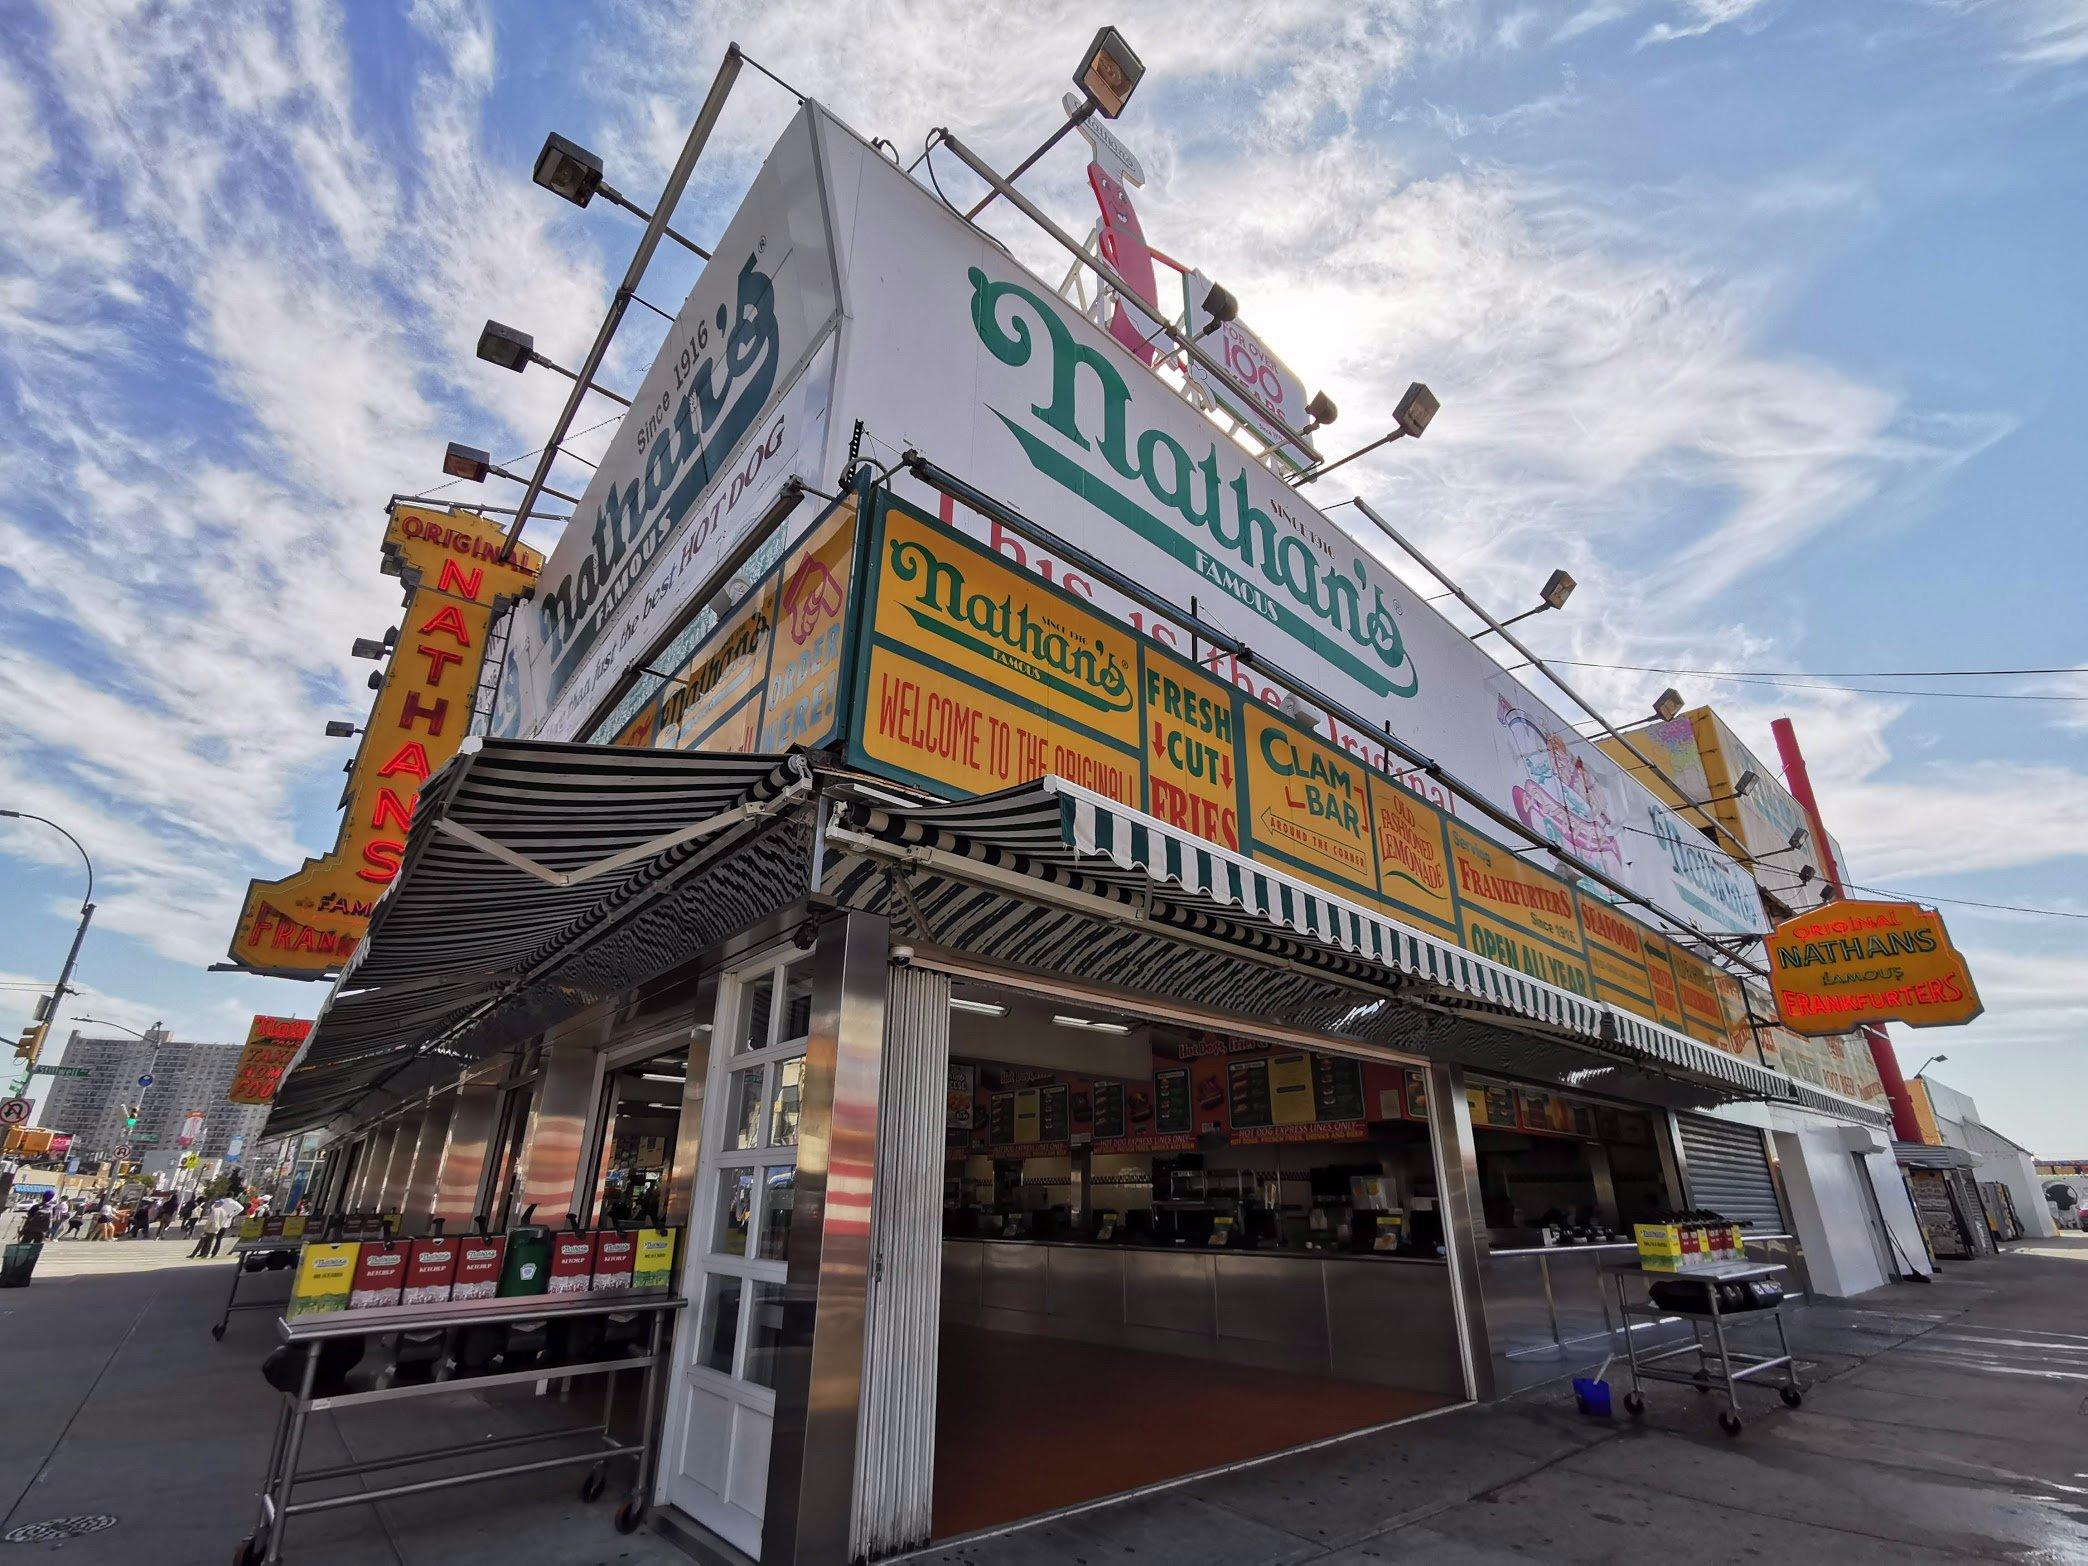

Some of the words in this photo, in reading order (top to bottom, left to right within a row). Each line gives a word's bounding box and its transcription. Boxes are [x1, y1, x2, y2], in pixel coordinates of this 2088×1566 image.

[1222, 321, 1246, 347] FOR
[1249, 343, 1278, 374] OVER
[1223, 335, 1283, 404] 100
[636, 390, 670, 455] Since
[673, 320, 709, 392] 1916
[967, 266, 1413, 690] Nathan's
[618, 614, 640, 652] the
[642, 563, 677, 621] best
[678, 493, 727, 577] HOT
[725, 413, 786, 516] DOG
[595, 507, 671, 632] FAMOUS
[1196, 549, 1278, 621] FAMOUS
[889, 538, 1133, 706] Nathan's
[768, 621, 841, 712] ORDER
[993, 648, 1041, 681] FAMOUS
[355, 557, 482, 885] NATHANS
[879, 672, 983, 770] WELCOME
[988, 716, 1011, 780] TO
[1017, 727, 1049, 785] THE
[1147, 668, 1232, 744] FRESH
[1206, 645, 1281, 709] the
[1327, 712, 1456, 816] riginal
[1167, 730, 1219, 785] CUT
[1259, 727, 1352, 800] CLAM
[1150, 775, 1240, 855] FRIES
[1305, 784, 1361, 841] BAR
[1380, 808, 1434, 861] FASHIONED
[1393, 795, 1416, 828] OLD
[1270, 817, 1308, 843] AROUND
[1312, 836, 1329, 853] THE
[1333, 845, 1365, 868] CORNER
[1378, 825, 1445, 889] LEMONADE
[1453, 830, 1493, 867] Serving
[318, 891, 373, 918] FAM
[1458, 856, 1573, 919] FRANKFURTERS
[1530, 912, 1554, 934] Since
[1581, 902, 1638, 954] SEAFOOD
[1777, 928, 1937, 970] NATHANS
[1792, 911, 1903, 940] ORIGINAL
[1471, 922, 1519, 971] OPEN
[1522, 944, 1551, 983] ALL
[1550, 954, 1587, 1001] YEAR
[1822, 966, 1905, 986] FAMOUS
[1781, 972, 1963, 1017] FRANKFURTERS
[40, 1066, 78, 1076] Stillwell
[1172, 1134, 1188, 1143] ONLY
[1239, 1128, 1255, 1138] HOT
[1256, 1127, 1273, 1137] DOG
[1275, 1125, 1307, 1136] EXPRESS
[1309, 1124, 1332, 1133] LINES
[1333, 1122, 1357, 1132] ONLY
